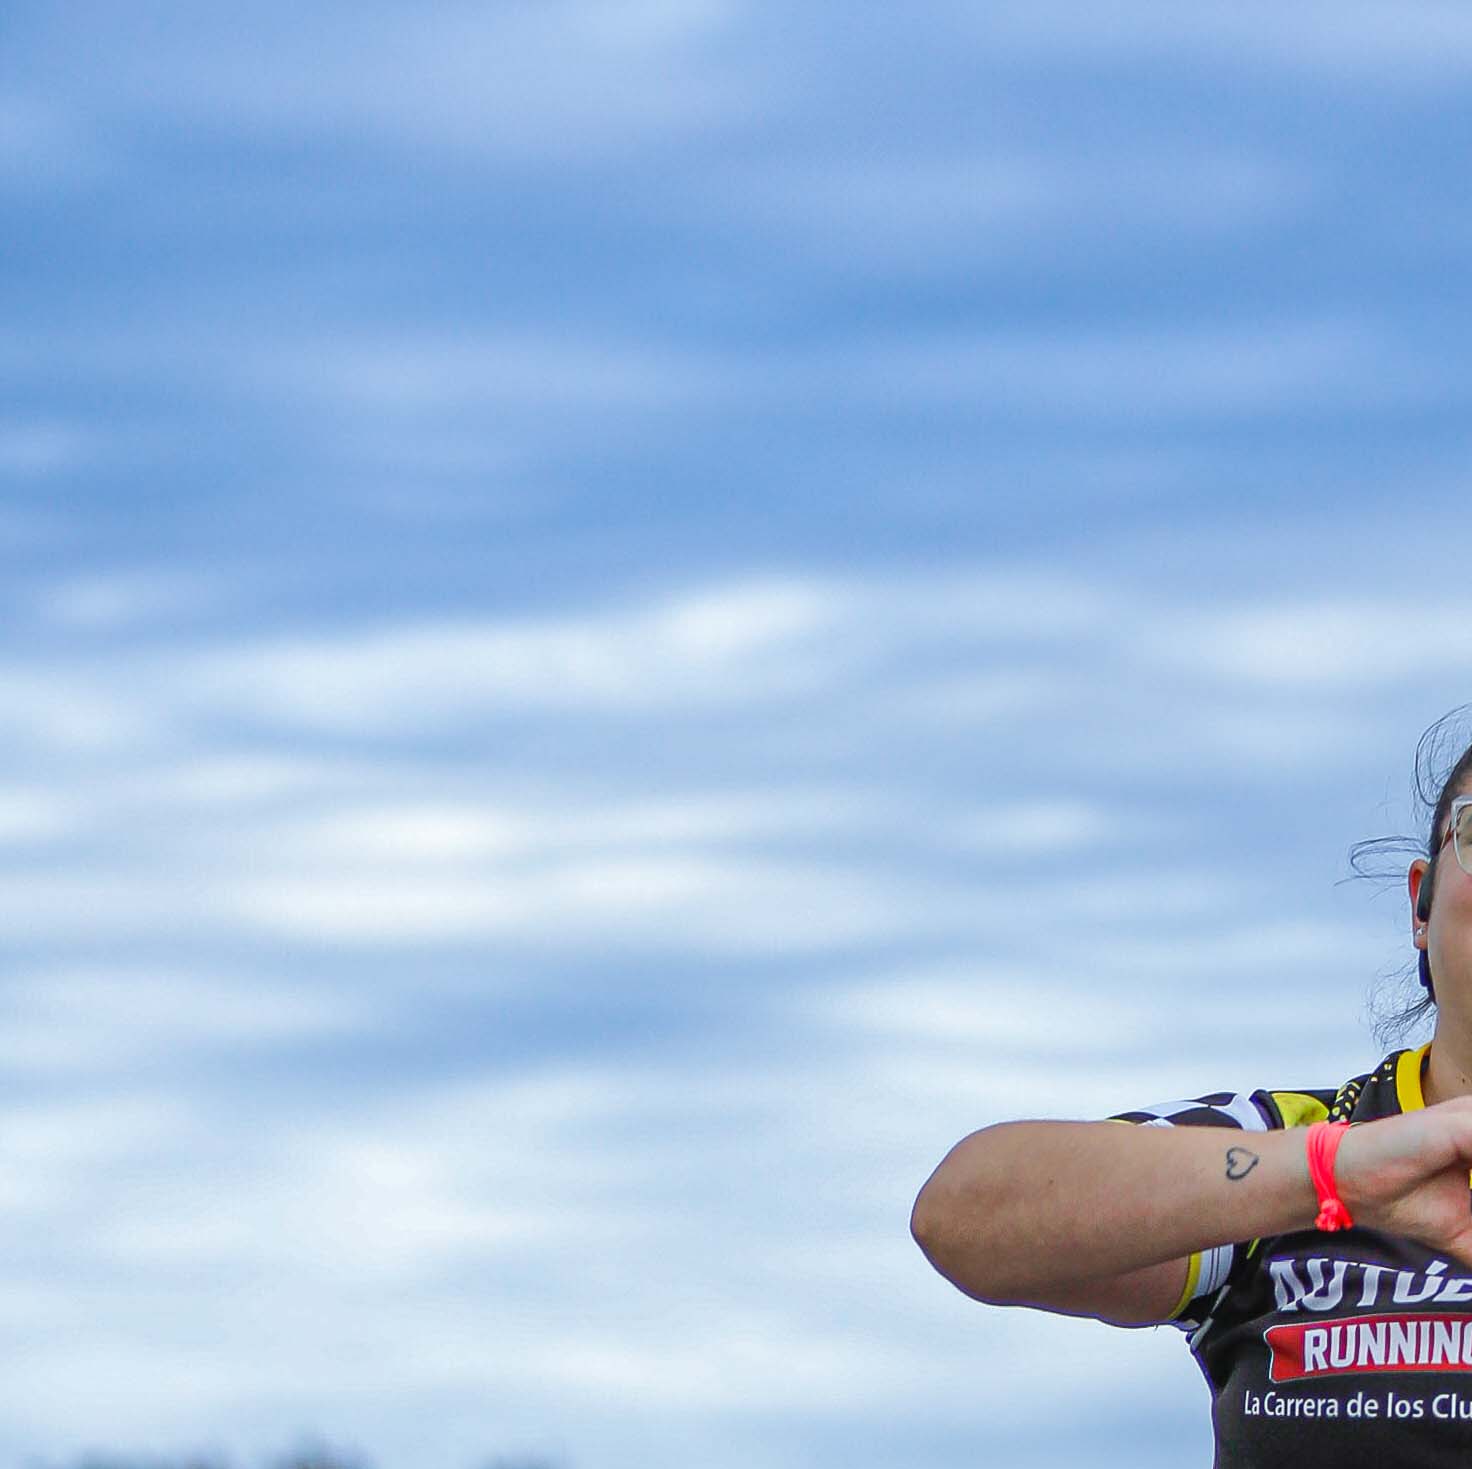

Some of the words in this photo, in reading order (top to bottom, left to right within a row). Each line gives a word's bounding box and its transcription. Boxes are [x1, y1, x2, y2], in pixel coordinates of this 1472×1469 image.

[1244, 1390, 1260, 1416] La
[1263, 1391, 1339, 1418] Carrera
[1346, 1392, 1379, 1418] de
[1387, 1392, 1425, 1418] los
